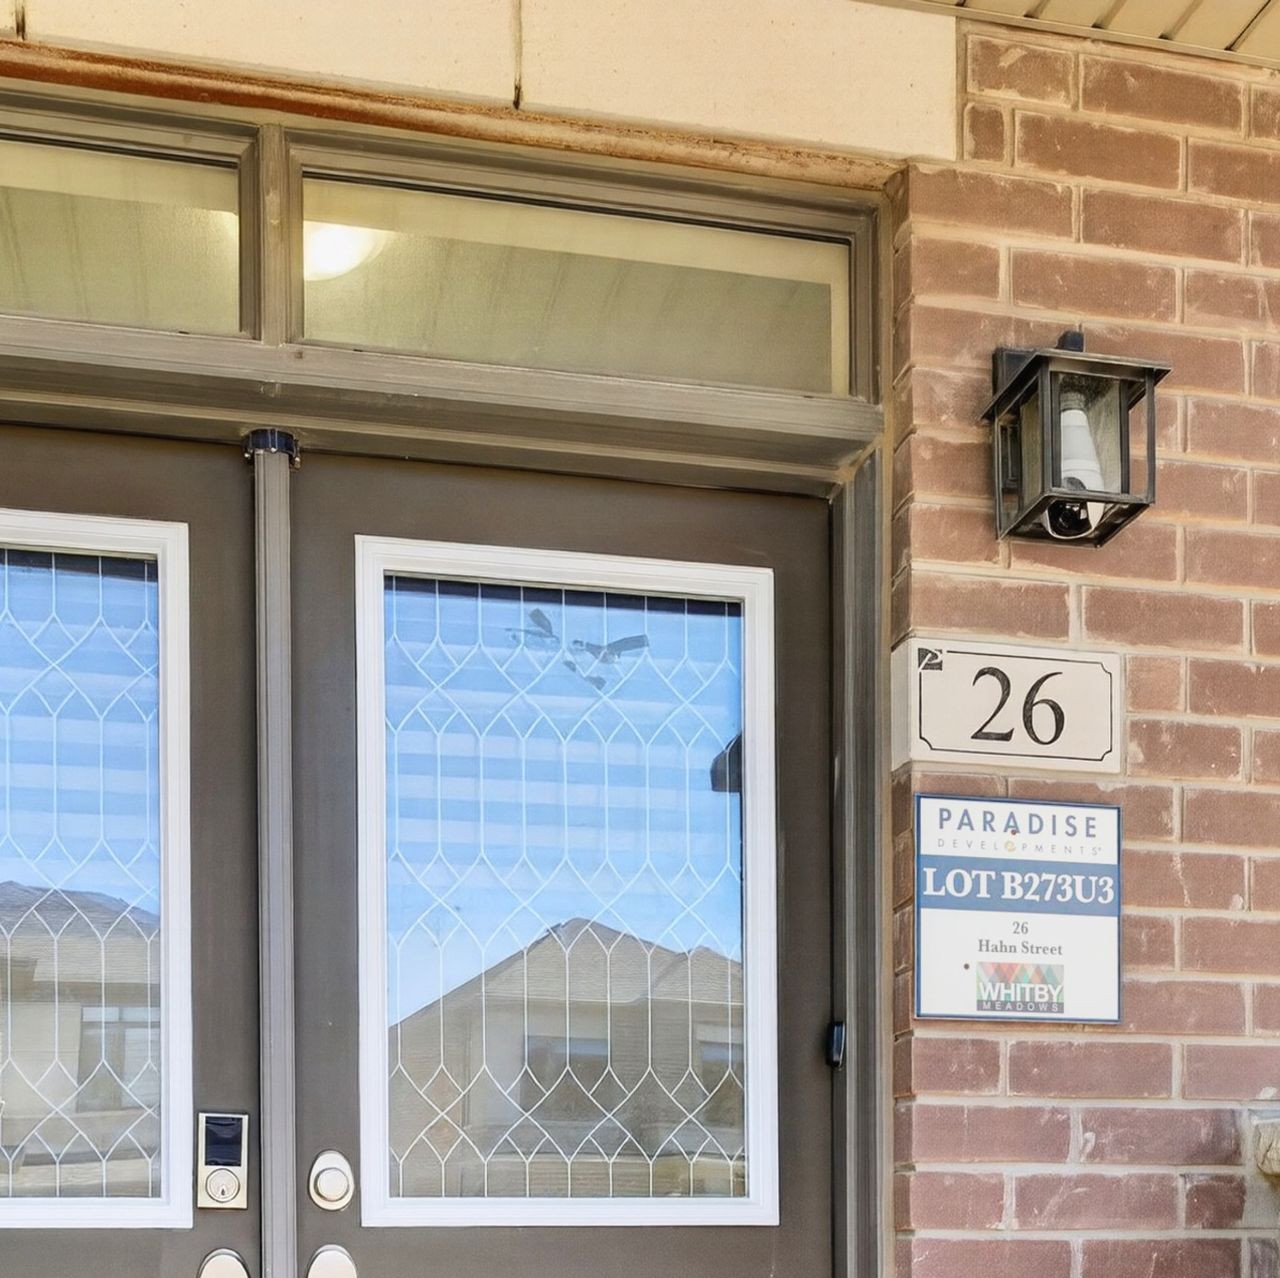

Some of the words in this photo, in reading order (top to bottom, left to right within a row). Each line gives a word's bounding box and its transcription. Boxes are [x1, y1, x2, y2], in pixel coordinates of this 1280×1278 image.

[970, 666, 1065, 746] 26
[938, 807, 1097, 838] PARADISE
[937, 838, 1099, 856] DEVELOPMENTS
[923, 867, 996, 899] LOT
[1000, 870, 1115, 905] B273U3
[1012, 921, 1029, 935] 26
[977, 939, 1018, 954] Hahn
[1021, 940, 1063, 956] Street
[978, 981, 1064, 1003] WHITBY
[982, 1001, 1059, 1013] MEADOWS
